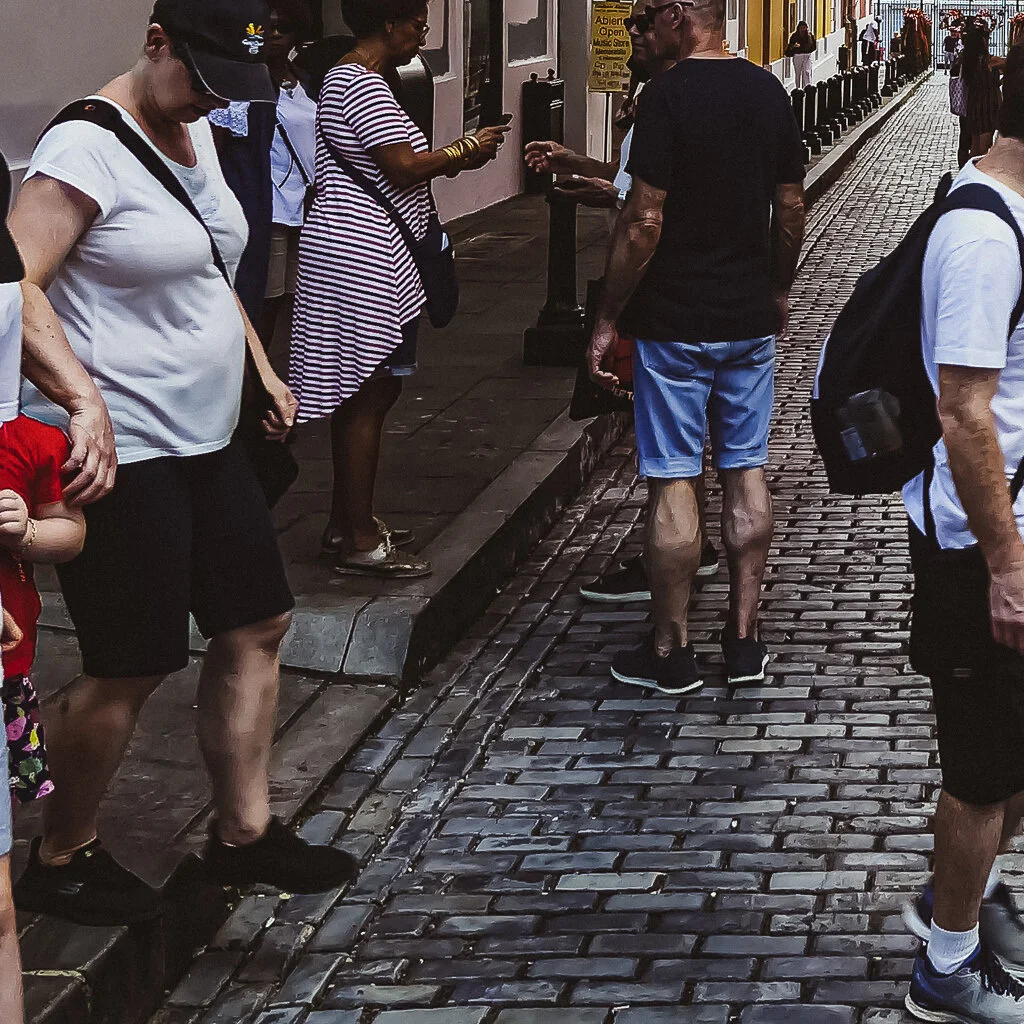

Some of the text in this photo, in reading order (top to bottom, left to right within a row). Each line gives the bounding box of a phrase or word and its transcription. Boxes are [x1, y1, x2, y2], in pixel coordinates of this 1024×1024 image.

[594, 15, 623, 26] Abiert
[599, 27, 624, 38] Open
[593, 38, 612, 47] Music
